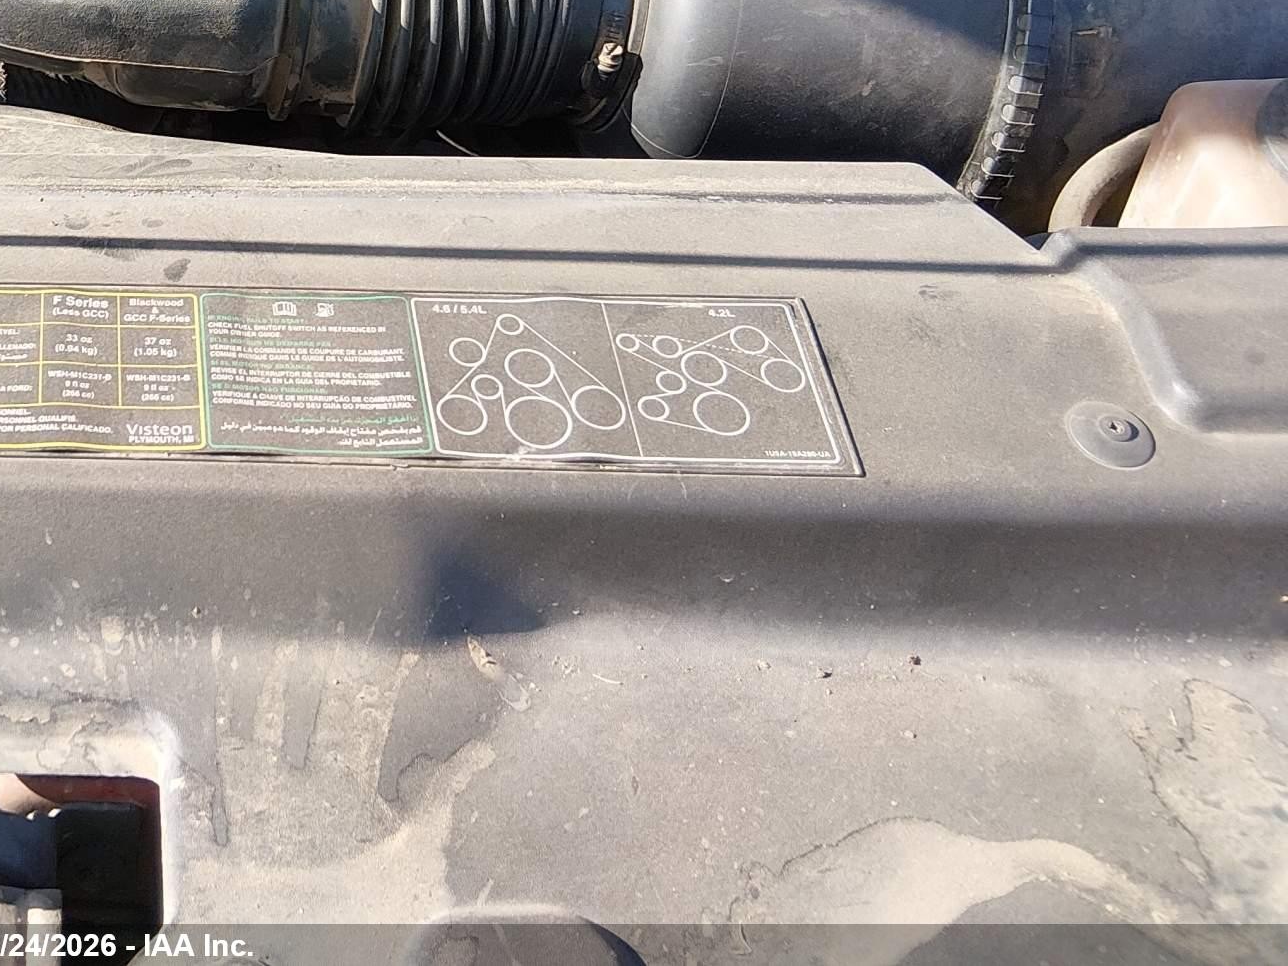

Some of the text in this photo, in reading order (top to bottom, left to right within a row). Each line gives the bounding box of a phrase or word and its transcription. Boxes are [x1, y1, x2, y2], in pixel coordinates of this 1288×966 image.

[53, 296, 109, 309] F Series
[129, 298, 184, 307] Blackwood
[53, 307, 109, 319] (Less GCC)
[461, 305, 487, 315] 5.4L
[708, 309, 735, 318] 4.2L
[124, 314, 191, 323] GCC F-Series
[234, 322, 252, 331] FUEL
[254, 324, 286, 332] SHUTOFF
[66, 334, 78, 342] 33
[144, 337, 157, 345] 37
[55, 343, 98, 356] (0.94 kg)
[134, 347, 177, 357] (1.05 kg)
[246, 376, 271, 384] INDICA
[213, 397, 255, 405] CONFORME
[256, 400, 292, 408] INDICADO
[126, 424, 193, 435] Visteon
